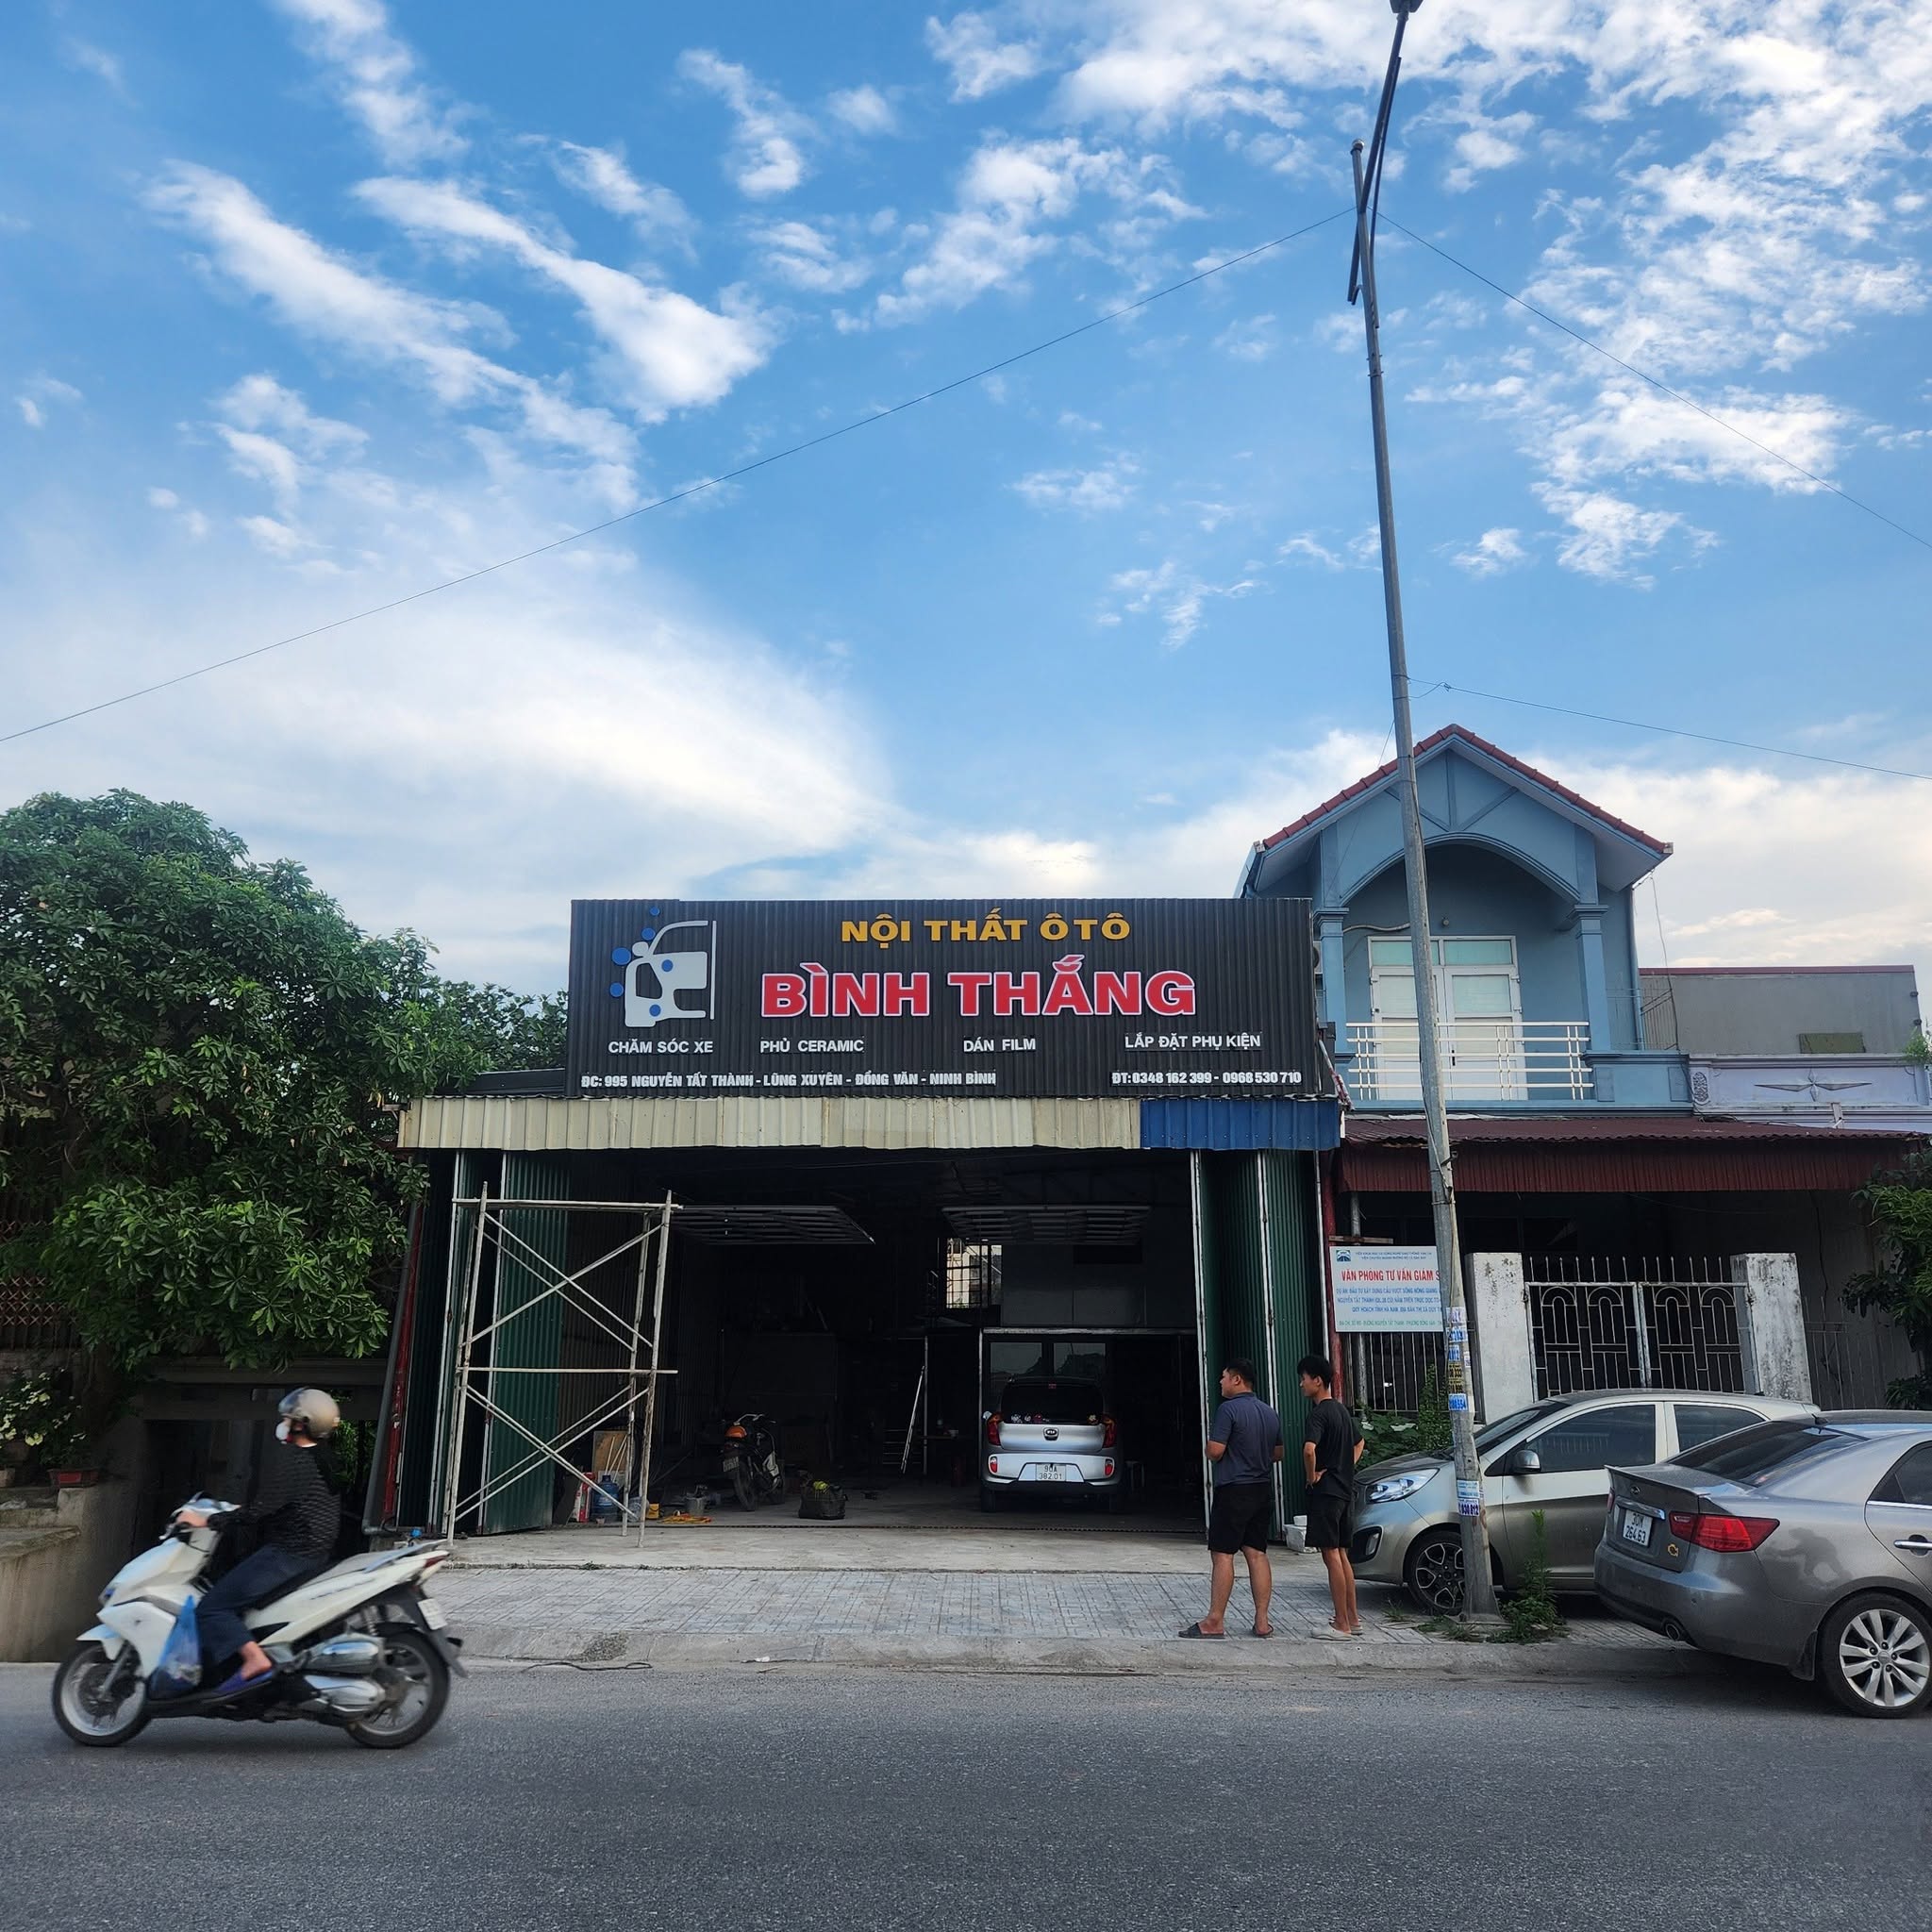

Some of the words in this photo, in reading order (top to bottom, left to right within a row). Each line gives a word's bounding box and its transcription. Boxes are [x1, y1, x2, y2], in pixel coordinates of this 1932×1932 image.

[841, 913, 911, 949] NỘI
[924, 907, 1028, 941] THẤT
[761, 962, 929, 1017] BÌNH
[947, 954, 1196, 1016] THẮNG
[608, 1039, 653, 1054] CHĂM
[657, 1038, 690, 1054] SÓC
[693, 1041, 713, 1054] XE
[760, 1037, 791, 1053] PHỦ
[797, 1040, 864, 1053] CERAMIC
[963, 1036, 994, 1052] DÁN
[1002, 1038, 1036, 1051] FILM
[1124, 1032, 1154, 1048] LẮP
[1158, 1032, 1188, 1050] ĐẶT
[1191, 1035, 1223, 1050] PHỤ
[1225, 1032, 1261, 1050] KIỆN
[581, 1075, 602, 1088] ĐC:
[604, 1075, 627, 1087] 995
[631, 1072, 682, 1088] NGUYỄN
[686, 1072, 708, 1087] TẤT
[710, 1072, 754, 1087] THÀNH
[763, 1073, 797, 1086] LŨNG
[801, 1072, 842, 1086] XUYÊN
[893, 1071, 919, 1085] VĂN
[929, 1073, 961, 1085] NINH
[965, 1071, 996, 1085] BÌNH
[1132, 1072, 1164, 1084] 0348
[1165, 1072, 1188, 1084] 162
[1189, 1072, 1212, 1084] 399
[1223, 1072, 1254, 1084] 0968
[1255, 1072, 1278, 1084] 530
[1279, 1072, 1302, 1084] 710
[1341, 1269, 1357, 1281] VĂN
